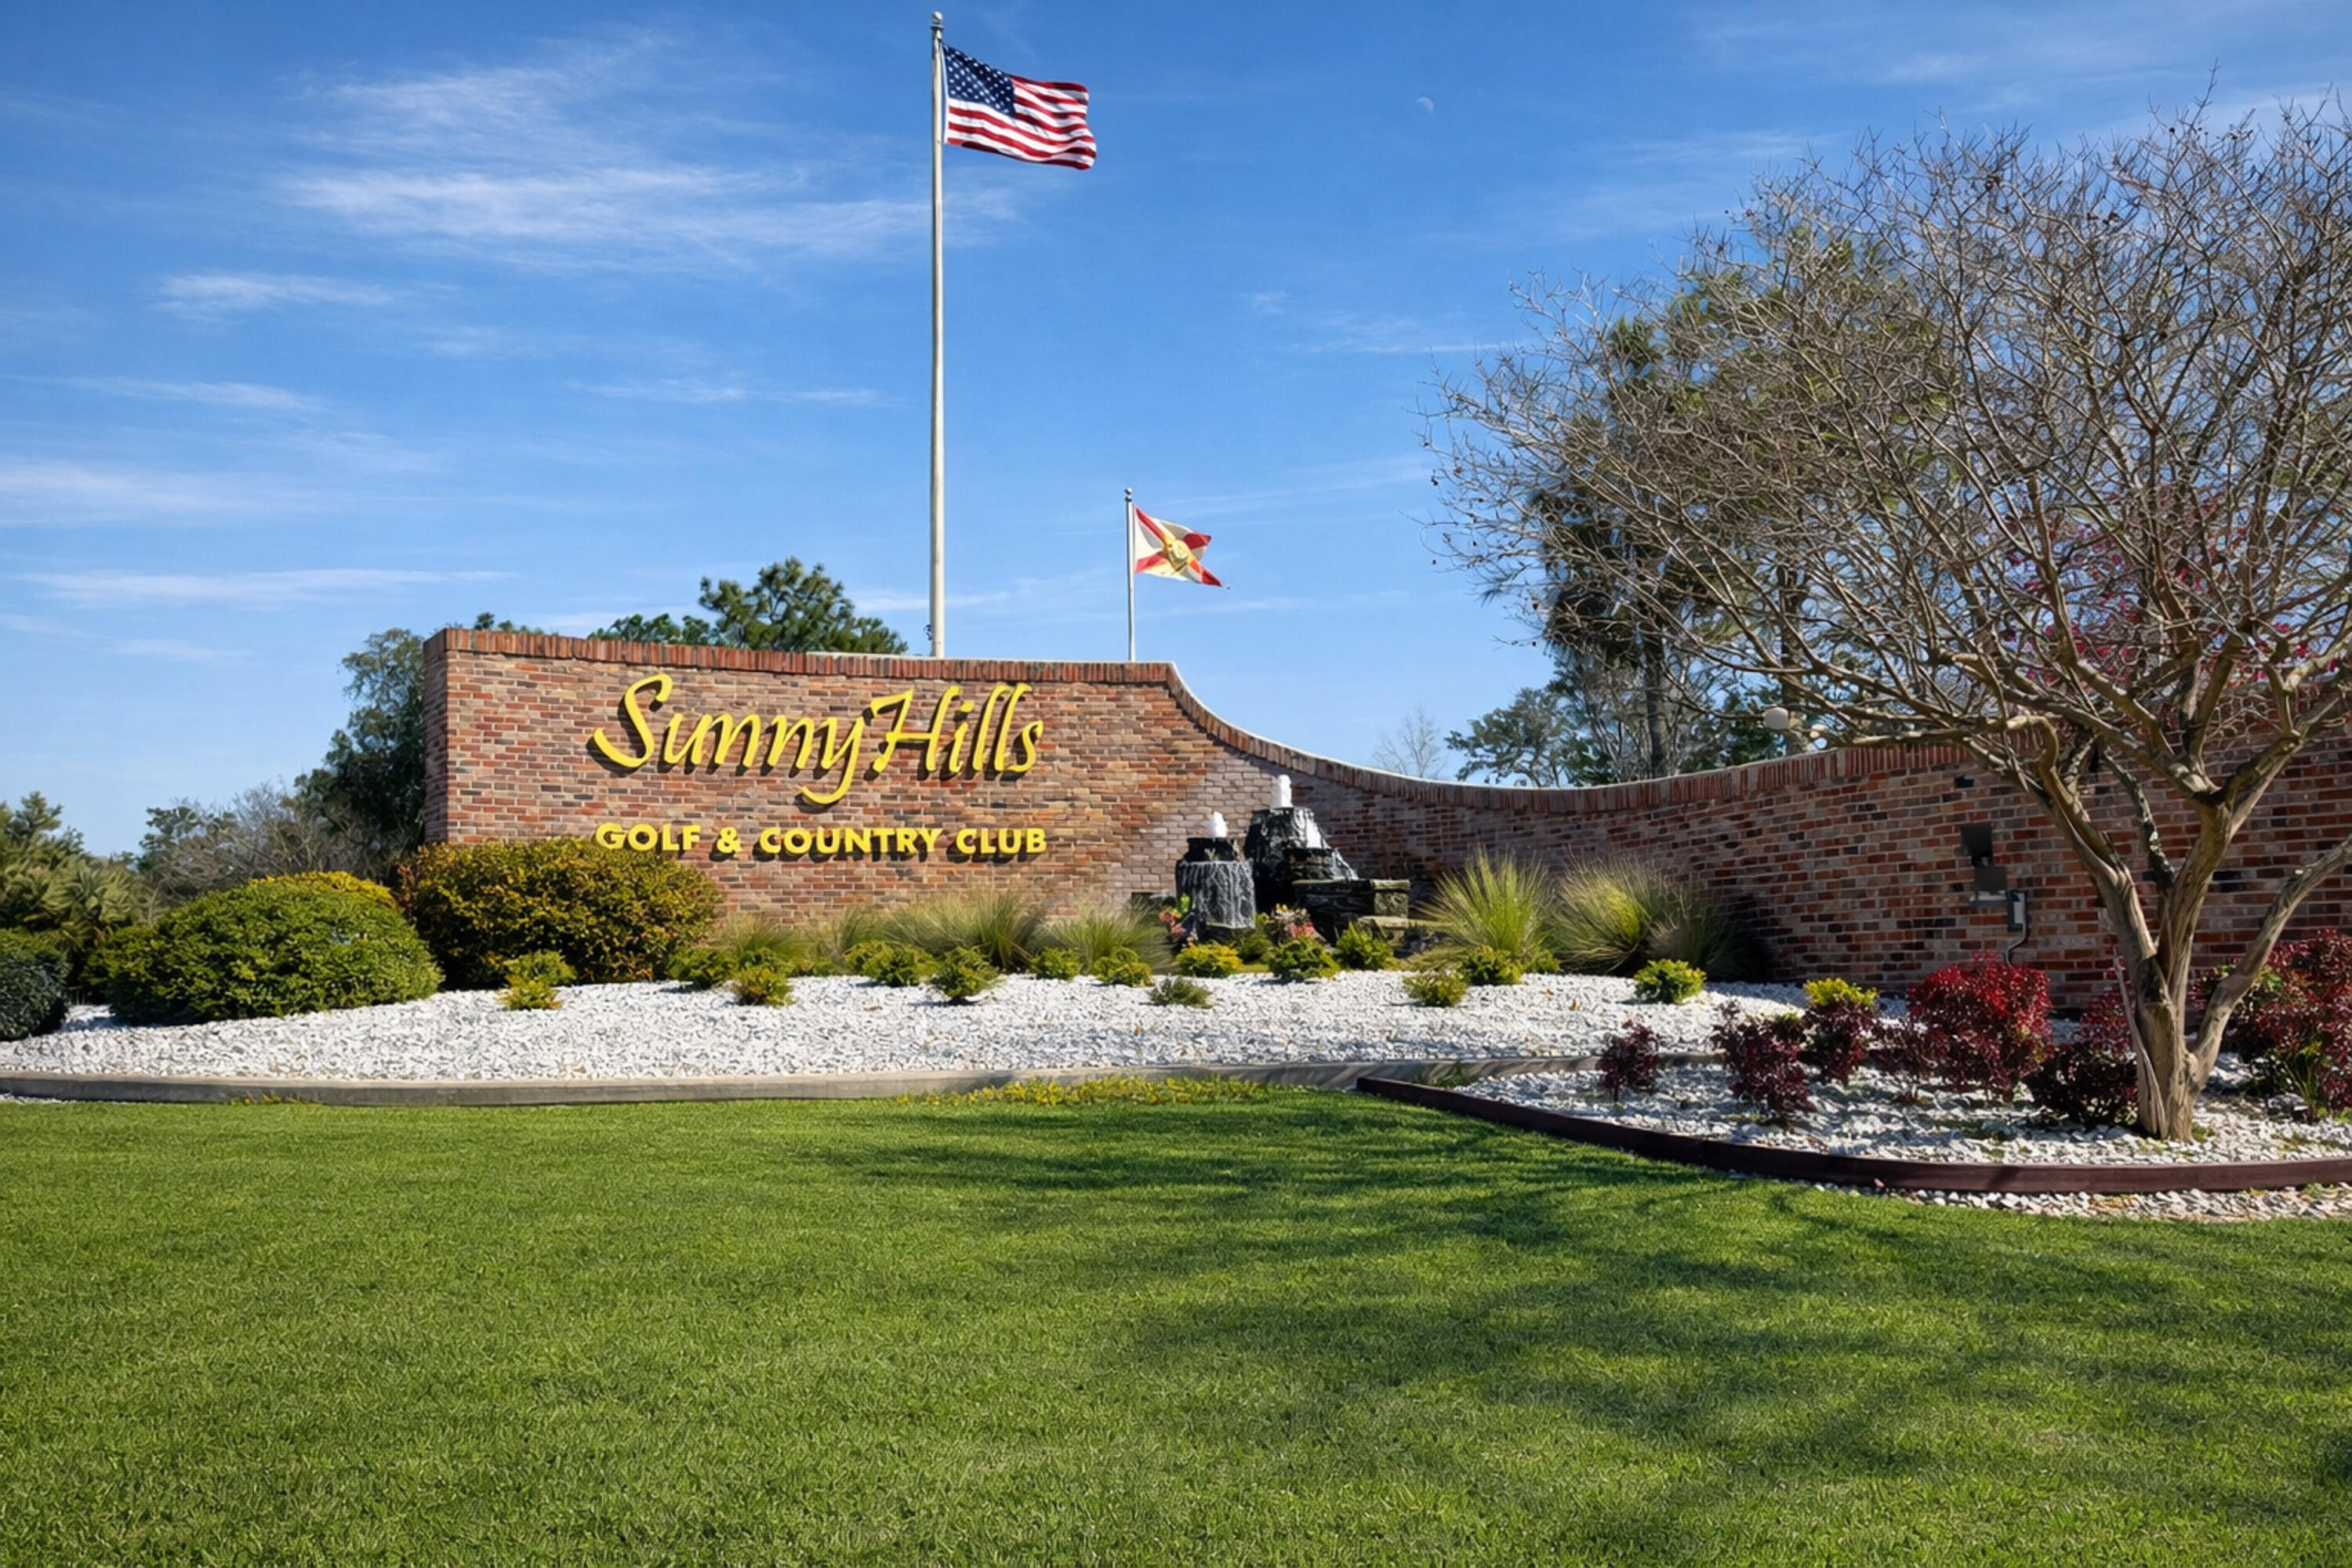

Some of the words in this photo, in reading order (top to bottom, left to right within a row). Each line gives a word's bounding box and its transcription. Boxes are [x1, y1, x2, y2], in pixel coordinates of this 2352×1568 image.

[592, 672, 865, 806] Sunny
[869, 682, 1044, 775] Hills
[595, 822, 702, 852] GOLF
[717, 826, 742, 854] &
[758, 826, 942, 855] COUNTRY
[955, 826, 1048, 855] CLUB
